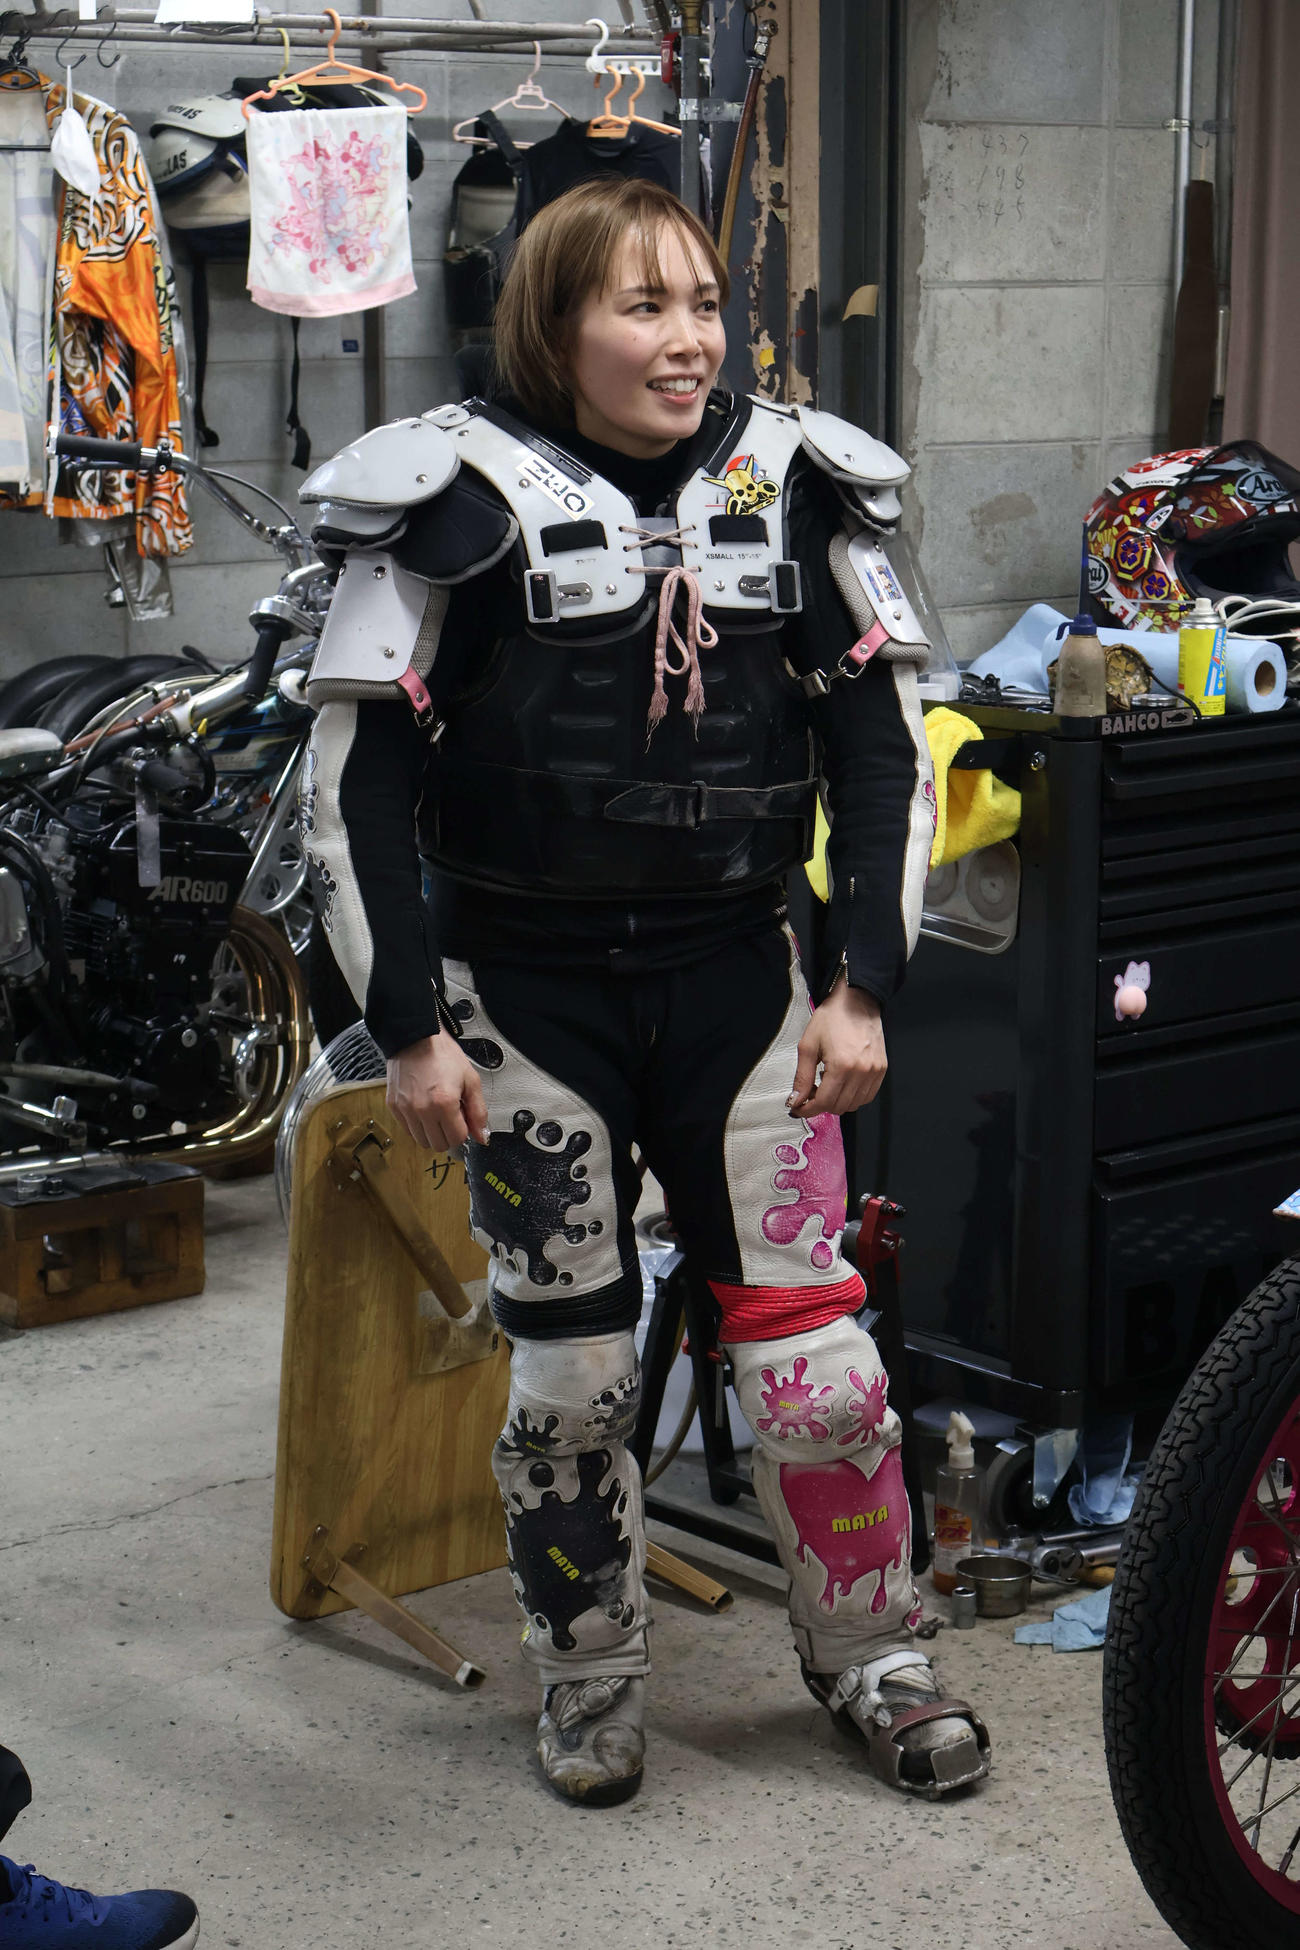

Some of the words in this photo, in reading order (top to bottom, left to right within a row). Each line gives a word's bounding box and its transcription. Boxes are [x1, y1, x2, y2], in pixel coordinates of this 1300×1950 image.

[1101, 712, 1160, 736] BAHCO
[147, 876, 229, 904] AR600
[484, 1172, 522, 1207] MAYA
[779, 1400, 800, 1412] MAYA
[525, 1440, 547, 1454] MAYA
[831, 1504, 889, 1534] MAYA
[546, 1546, 581, 1582] MAYA
